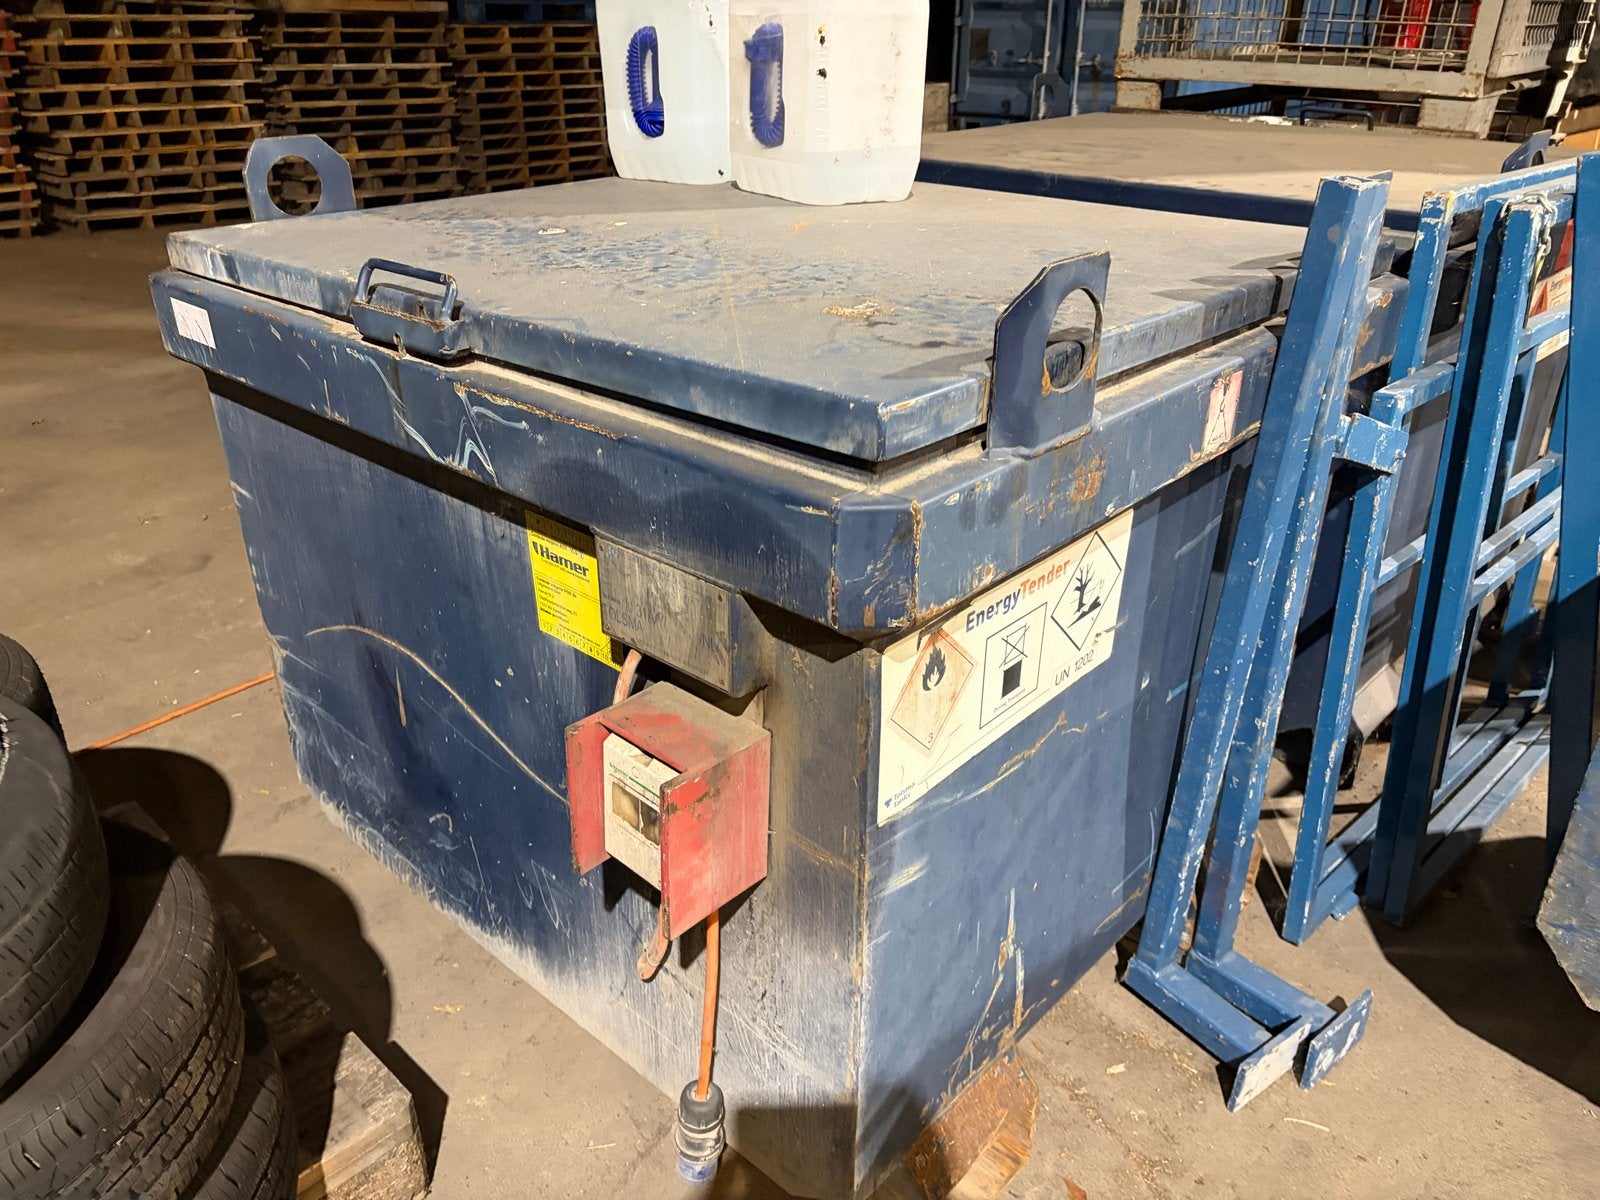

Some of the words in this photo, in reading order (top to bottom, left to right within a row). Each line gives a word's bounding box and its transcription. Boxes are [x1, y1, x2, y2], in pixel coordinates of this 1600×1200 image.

[540, 543, 589, 577] Hamer
[966, 560, 1070, 632] EnergyTender
[603, 603, 643, 632] TOLSMA
[1055, 670, 1070, 685] UN
[1074, 649, 1095, 672] 1202
[928, 732, 934, 744] 3
